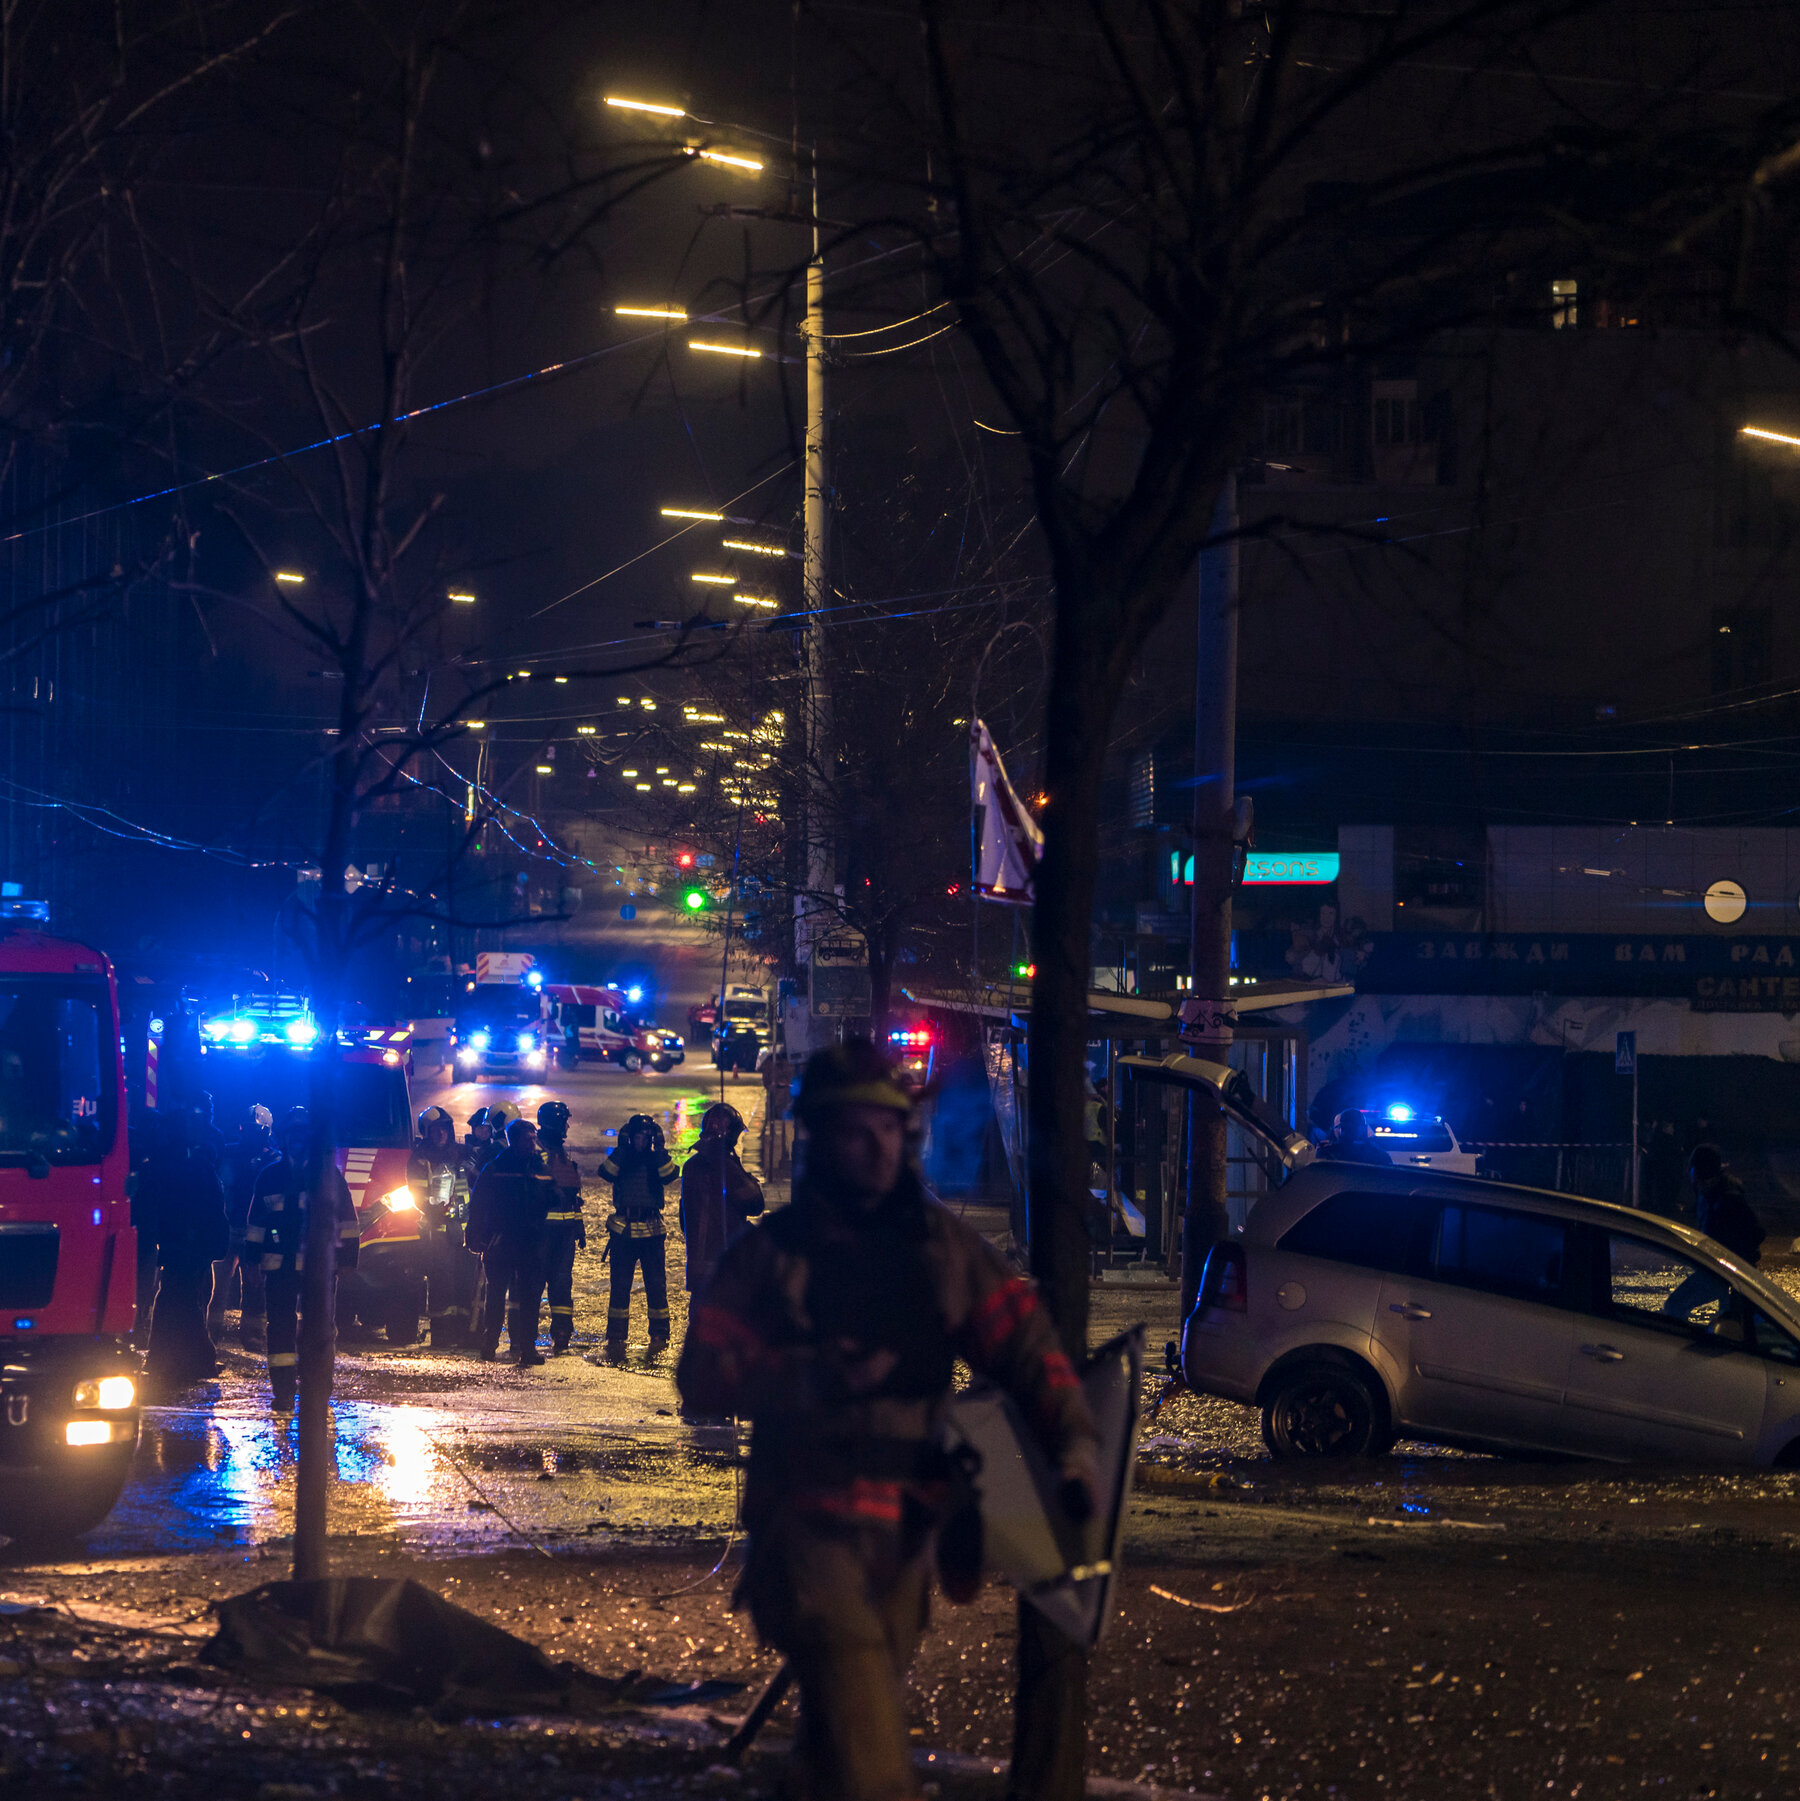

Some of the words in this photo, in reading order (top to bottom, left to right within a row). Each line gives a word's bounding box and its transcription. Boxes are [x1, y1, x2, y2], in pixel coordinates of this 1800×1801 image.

[1246, 861, 1319, 877] tsons
[1416, 941, 1569, 965] ЗАВЖДИ
[1614, 943, 1687, 962] ВАМ
